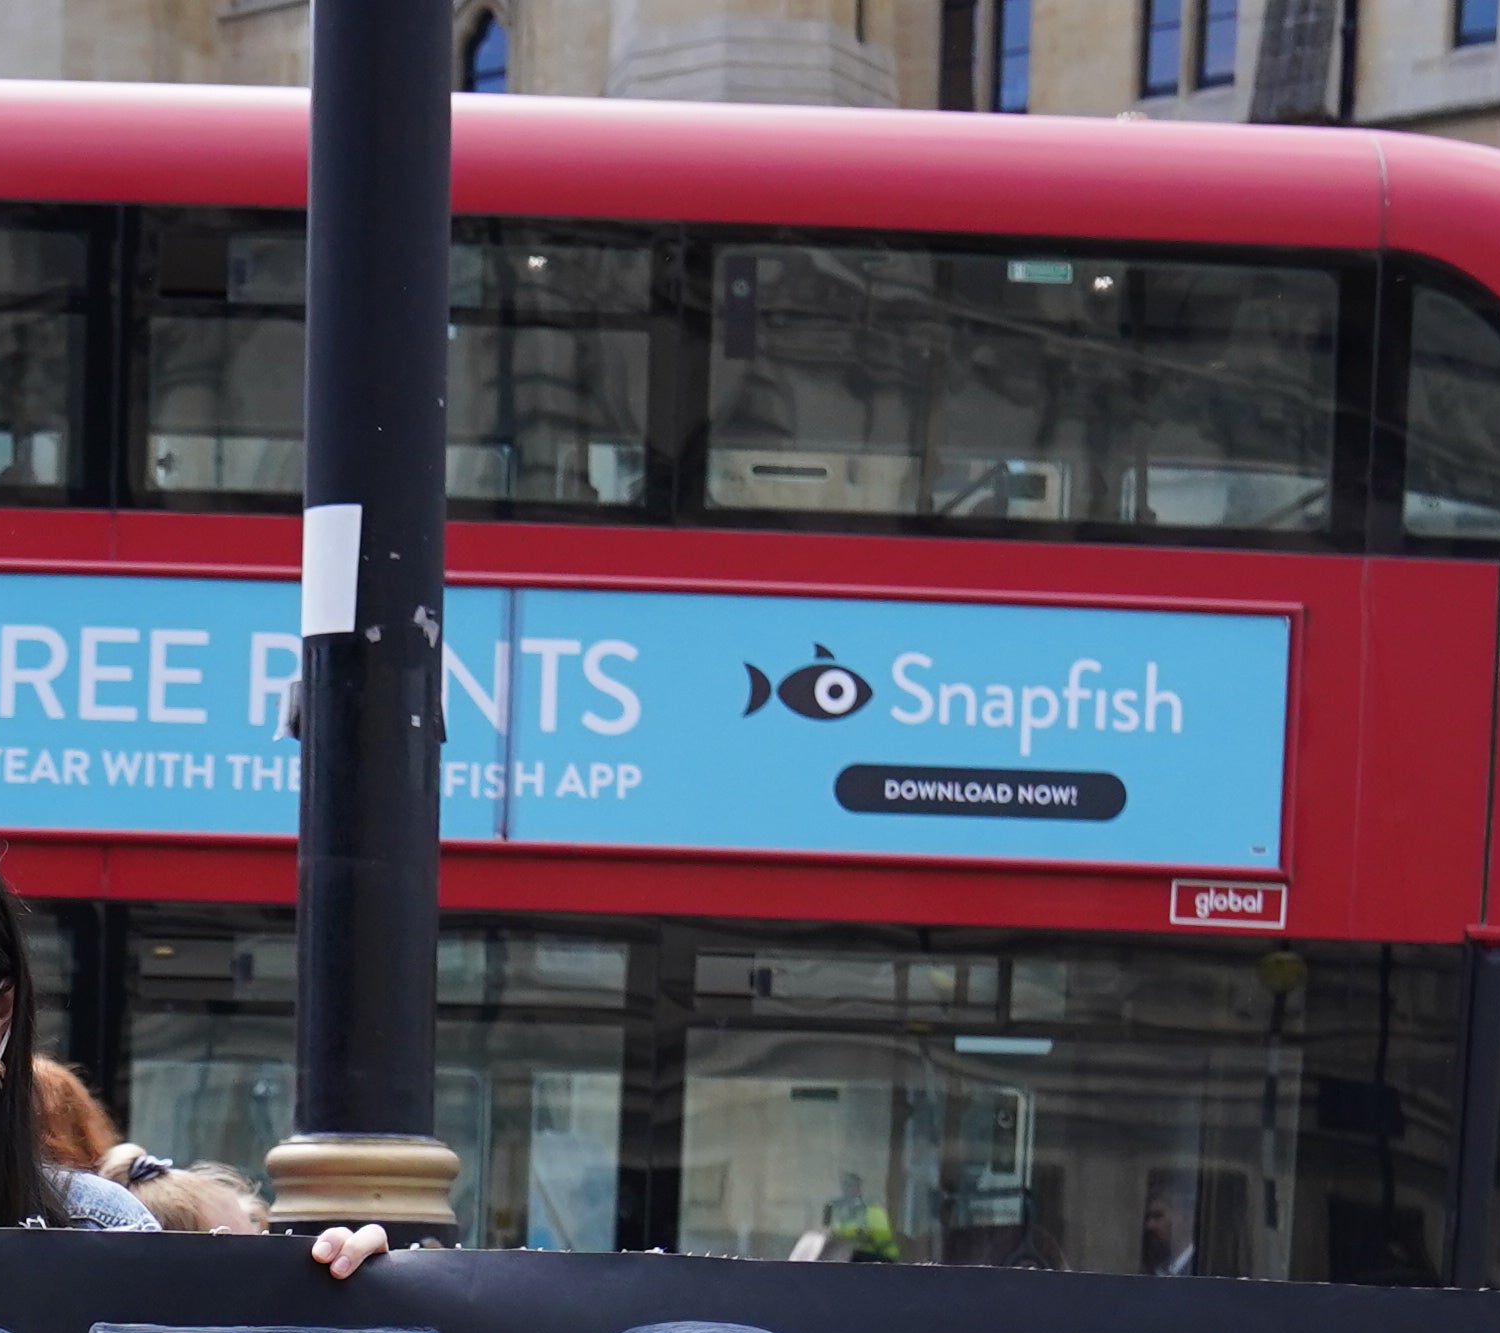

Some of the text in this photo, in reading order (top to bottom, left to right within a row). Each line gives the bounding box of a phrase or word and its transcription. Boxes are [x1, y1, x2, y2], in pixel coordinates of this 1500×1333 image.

[248, 630, 642, 736] PNTS
[889, 652, 1184, 757] Snapfish
[103, 751, 215, 790] WITH
[226, 754, 300, 791] THE
[445, 761, 545, 799] FISH
[555, 763, 642, 800] APP
[884, 779, 1078, 806] DOWNLOAD NOW!
[1195, 887, 1263, 919] global
